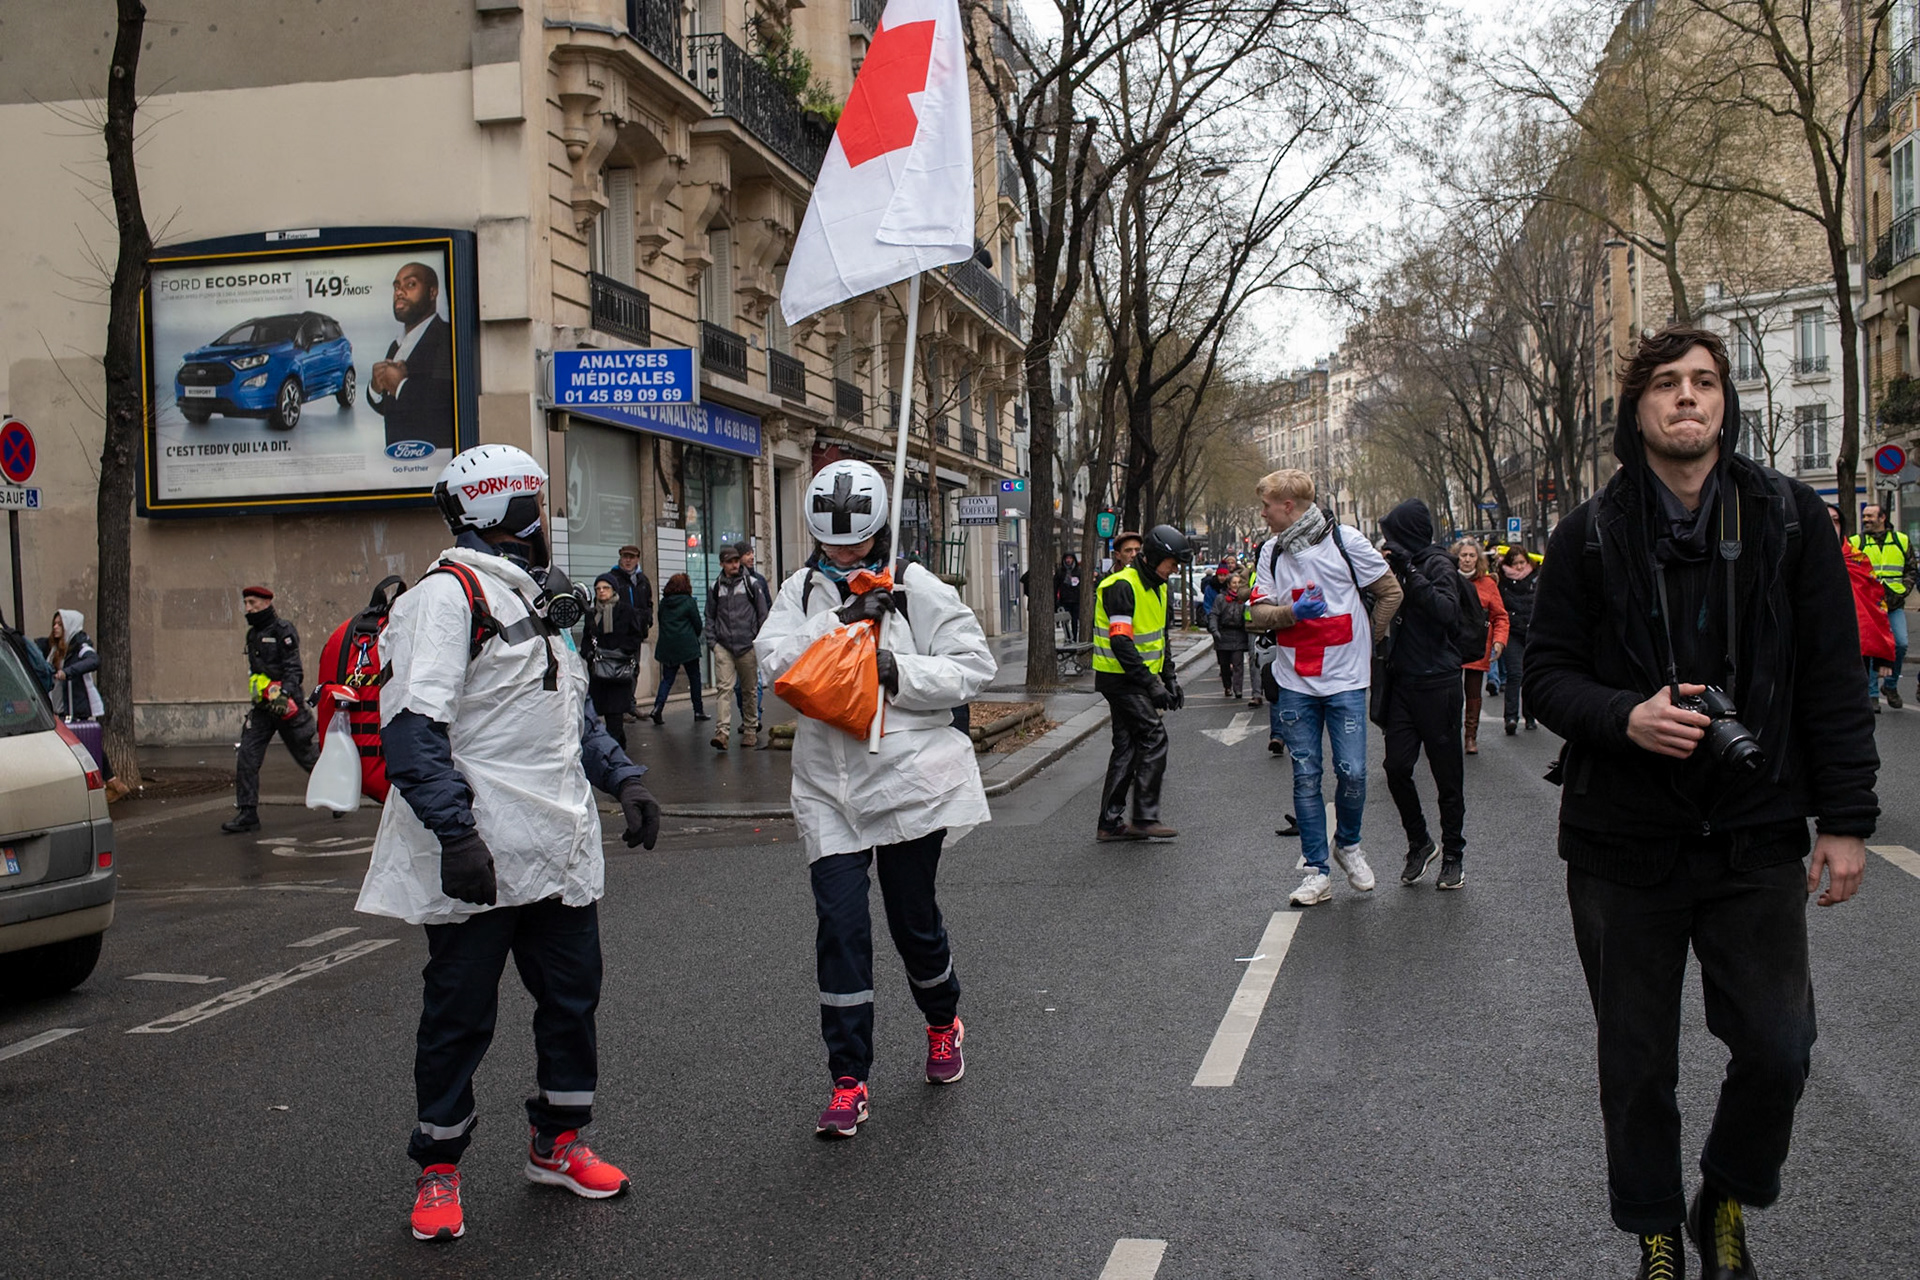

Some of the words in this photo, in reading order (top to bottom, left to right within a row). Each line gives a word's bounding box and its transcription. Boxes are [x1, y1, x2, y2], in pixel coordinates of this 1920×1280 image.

[161, 278, 201, 292] FORD
[205, 271, 292, 289] ECOSPORT
[579, 353, 668, 369] ANALYSES
[571, 370, 675, 386] MÉDICALES
[565, 390, 583, 403] 01
[589, 389, 608, 402] 45
[613, 389, 632, 402] 89
[637, 388, 657, 401] 09
[662, 388, 682, 401] 69
[650, 405, 709, 435] DANALYSES
[714, 416, 722, 434] 01
[723, 418, 732, 437] 45
[732, 420, 740, 439] 89
[740, 423, 748, 441] 09
[748, 425, 756, 444] 69
[166, 445, 196, 457] C'EST
[197, 443, 230, 456] TEDDY
[232, 442, 250, 456] QUI
[253, 441, 268, 453] L'A
[271, 440, 291, 452] DIT.
[394, 443, 426, 458] Ford
[392, 465, 403, 473] Go
[403, 465, 429, 473] Further
[461, 475, 509, 500] BORN
[509, 478, 522, 492] TO
[1003, 481, 1022, 491] CIC
[0, 491, 25, 504] SAUF
[968, 497, 990, 505] TONY
[960, 505, 996, 515] COIFFURE
[8, 861, 19, 872] 31
